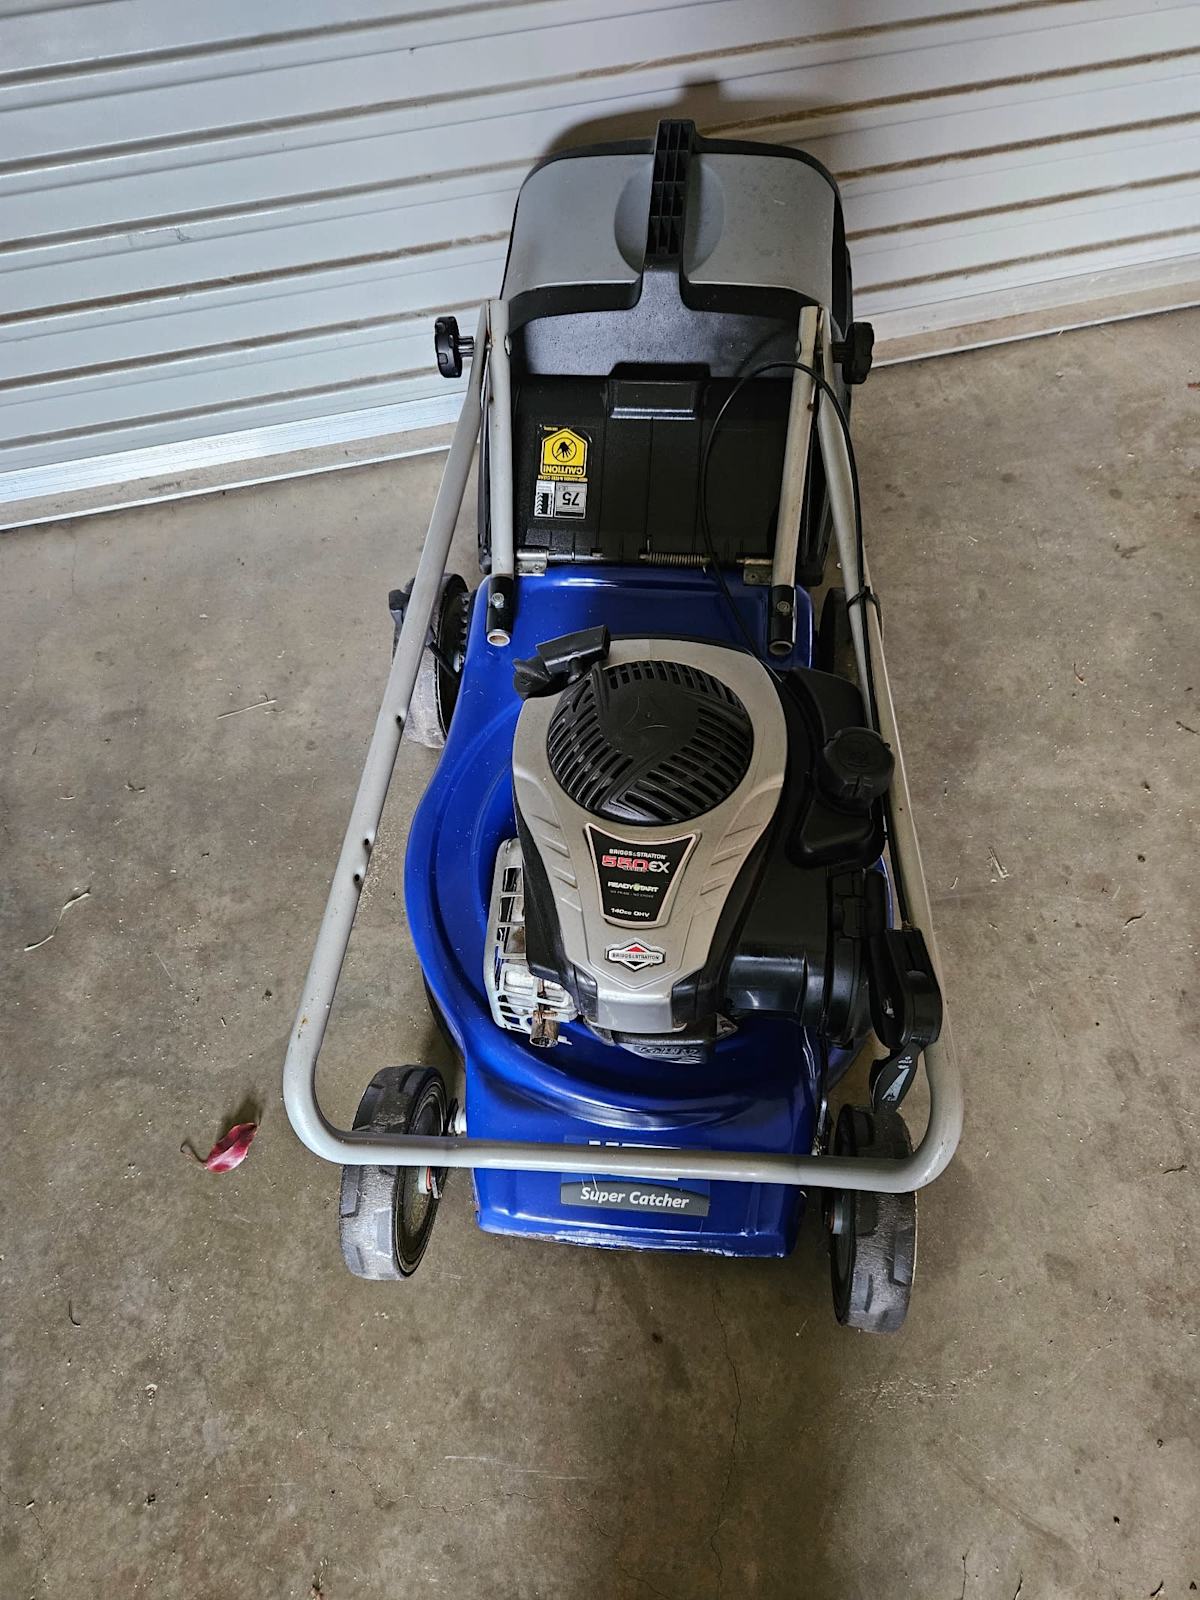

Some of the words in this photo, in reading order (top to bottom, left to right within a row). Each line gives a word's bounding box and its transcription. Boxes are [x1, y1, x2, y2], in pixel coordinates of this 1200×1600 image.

[543, 465, 583, 474] CAUTION!
[562, 492, 580, 506] 75
[633, 910, 650, 918] OHV
[580, 1186, 625, 1204] Super
[629, 1191, 690, 1209] Catcher
